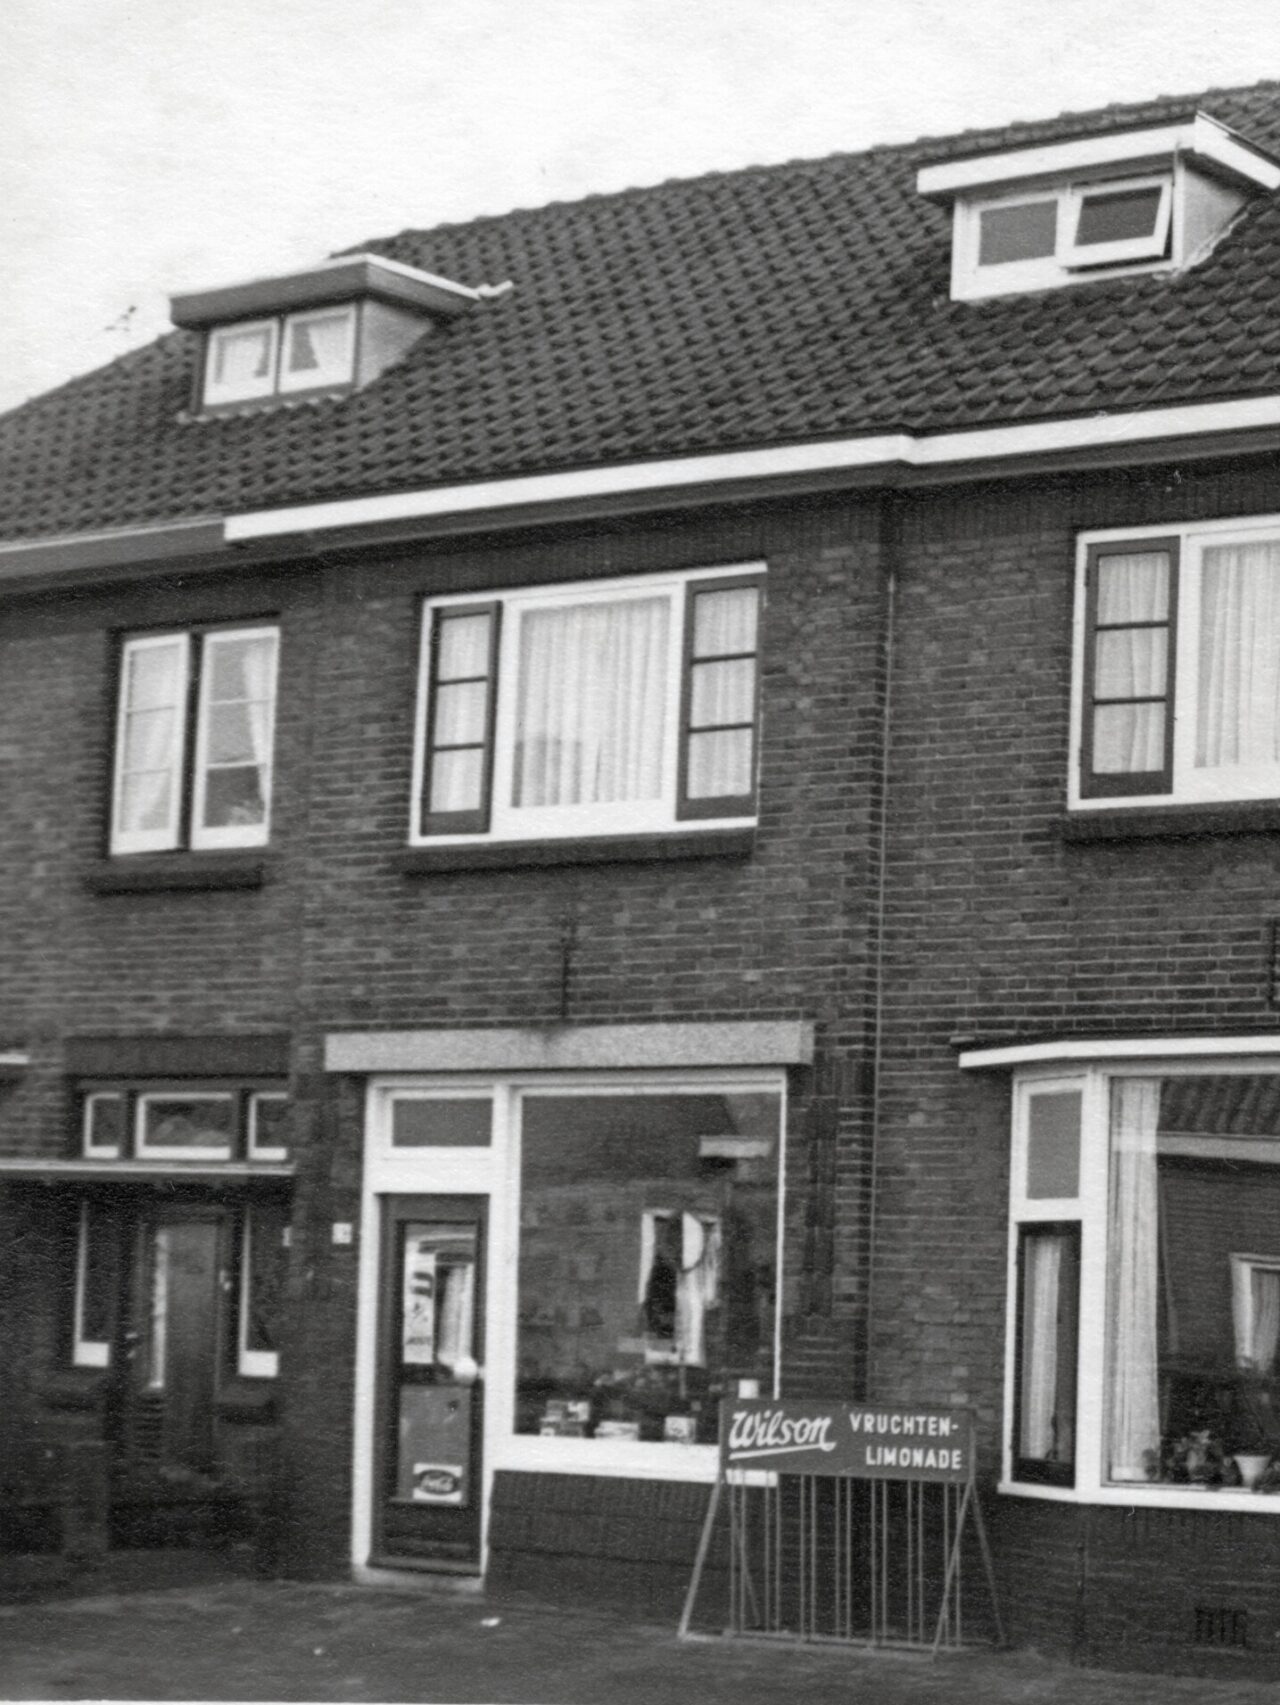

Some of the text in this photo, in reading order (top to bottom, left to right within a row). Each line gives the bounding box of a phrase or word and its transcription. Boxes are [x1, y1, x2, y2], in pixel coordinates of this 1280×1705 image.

[728, 1409, 837, 1453] Wilson
[849, 1413, 959, 1437] VRUCHTEN-
[865, 1445, 962, 1470] LIMONADE
